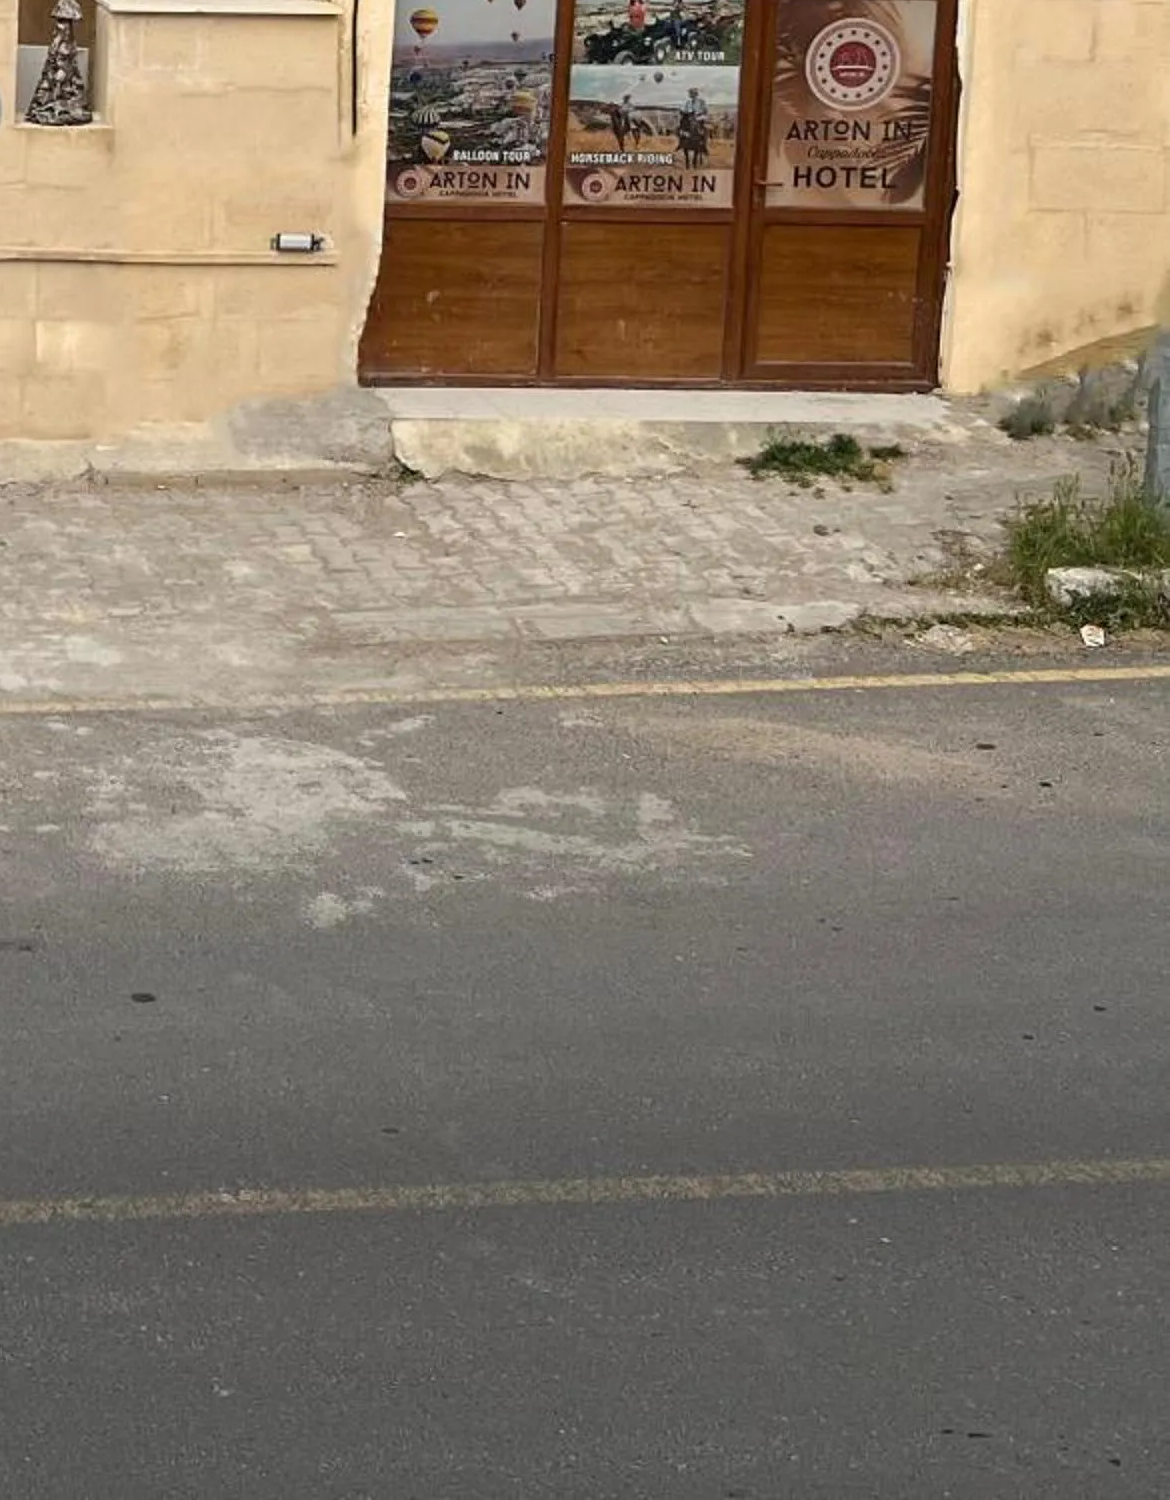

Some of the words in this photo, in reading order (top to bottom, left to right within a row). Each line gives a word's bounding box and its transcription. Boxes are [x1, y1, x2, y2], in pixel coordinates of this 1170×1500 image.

[697, 51, 725, 61] TOUR
[785, 118, 871, 141] ARTON
[881, 119, 913, 142] IN
[453, 149, 499, 161] BALLOON
[503, 150, 531, 161] TOUR
[571, 153, 633, 164] HORSEBACK
[637, 154, 674, 165] RIDING
[430, 171, 498, 189] ARTON
[506, 171, 530, 190] IN
[614, 174, 684, 192] ARTON
[692, 175, 717, 193] IN
[792, 165, 898, 189] HOTEL
